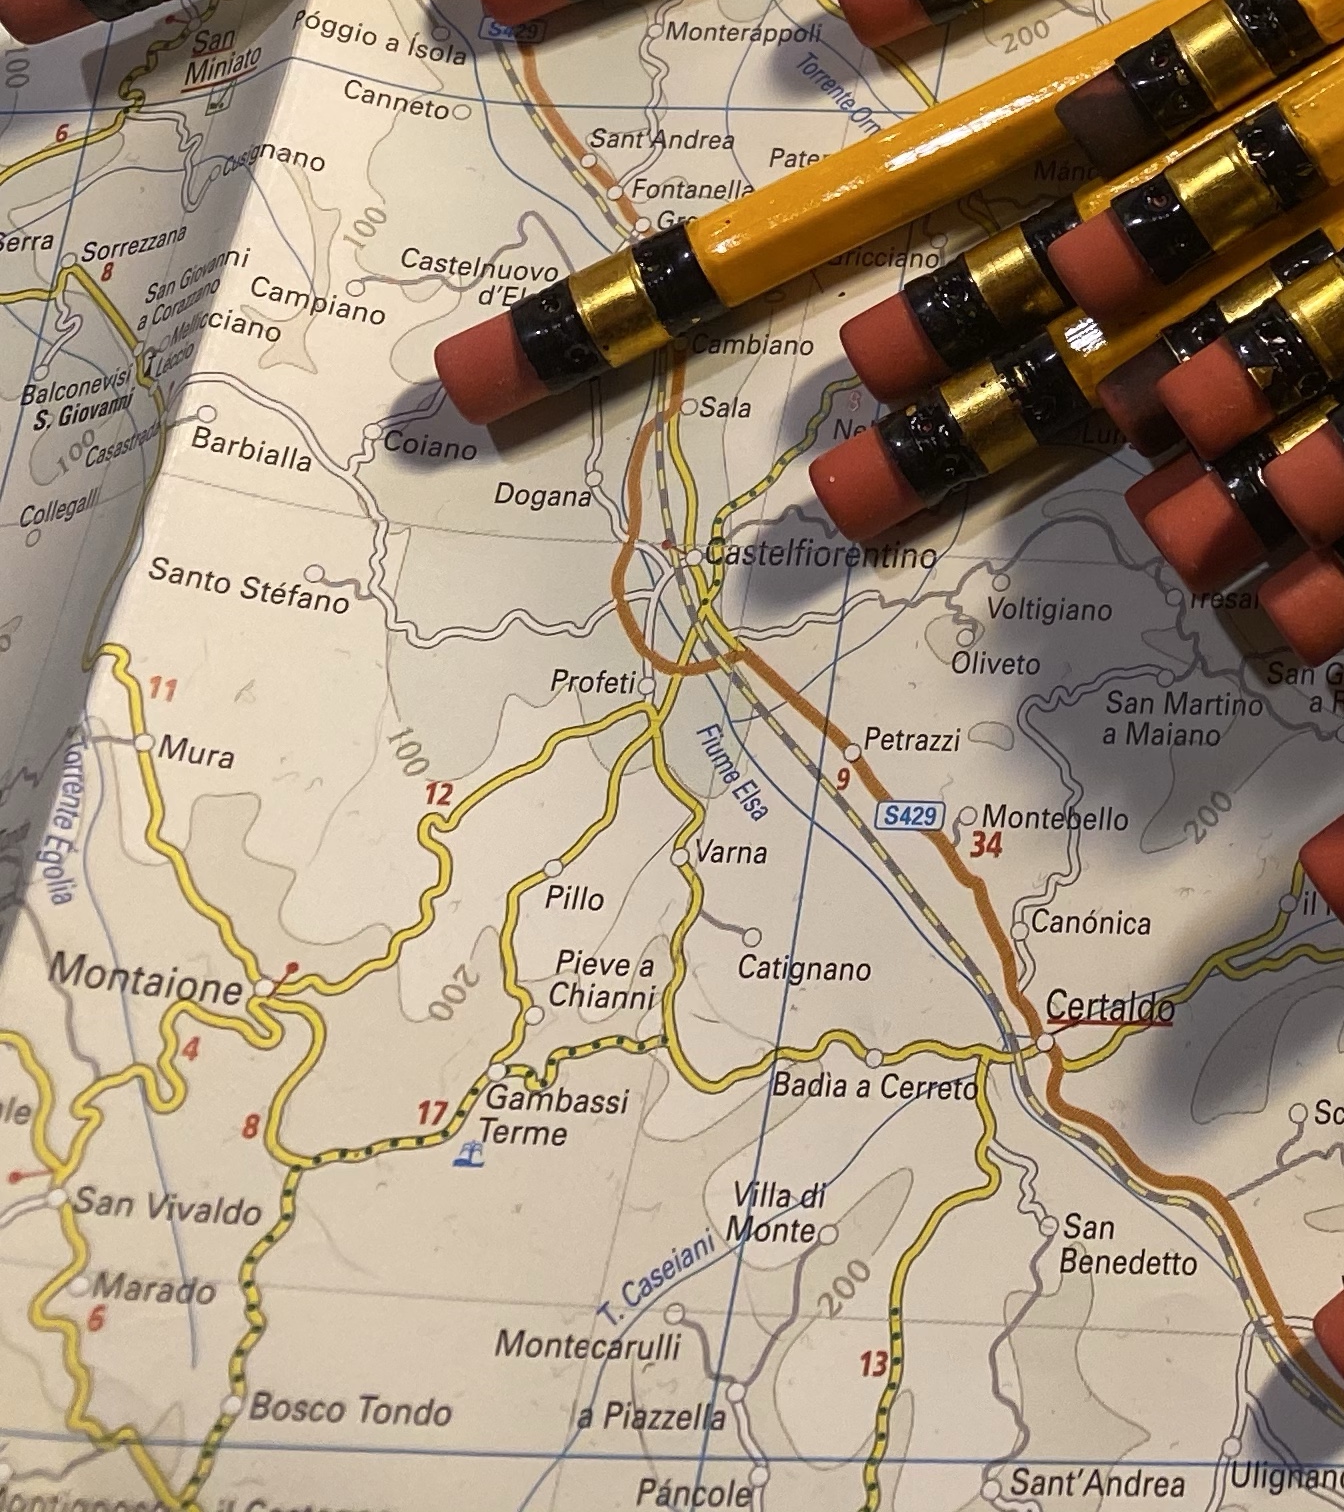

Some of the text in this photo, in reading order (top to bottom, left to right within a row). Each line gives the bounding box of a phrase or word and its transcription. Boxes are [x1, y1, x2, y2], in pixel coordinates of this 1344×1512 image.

[344, 80, 451, 120] Canneto
[401, 248, 558, 283] Castelnuovo
[250, 277, 386, 327] Campiano
[699, 396, 751, 419] Sala
[192, 426, 312, 472] Barbialla
[704, 541, 938, 571] Castelfiorentino
[149, 557, 350, 616] Santo Stéfano
[551, 670, 635, 696] Profeti
[156, 734, 235, 770] Mura
[864, 726, 960, 753] Petrazzi
[884, 805, 936, 827] S429
[982, 804, 1129, 830] Montebello
[697, 839, 767, 864] Varna
[969, 830, 1002, 858] 34
[1031, 908, 1151, 936] Canónica
[49, 950, 242, 1007] Montaione
[739, 956, 871, 983] Catignano
[1046, 988, 1176, 1024] Certaldo
[486, 1085, 629, 1116] Gambassi
[480, 1118, 568, 1147] Terme
[1060, 1250, 1198, 1276] Benedetto
